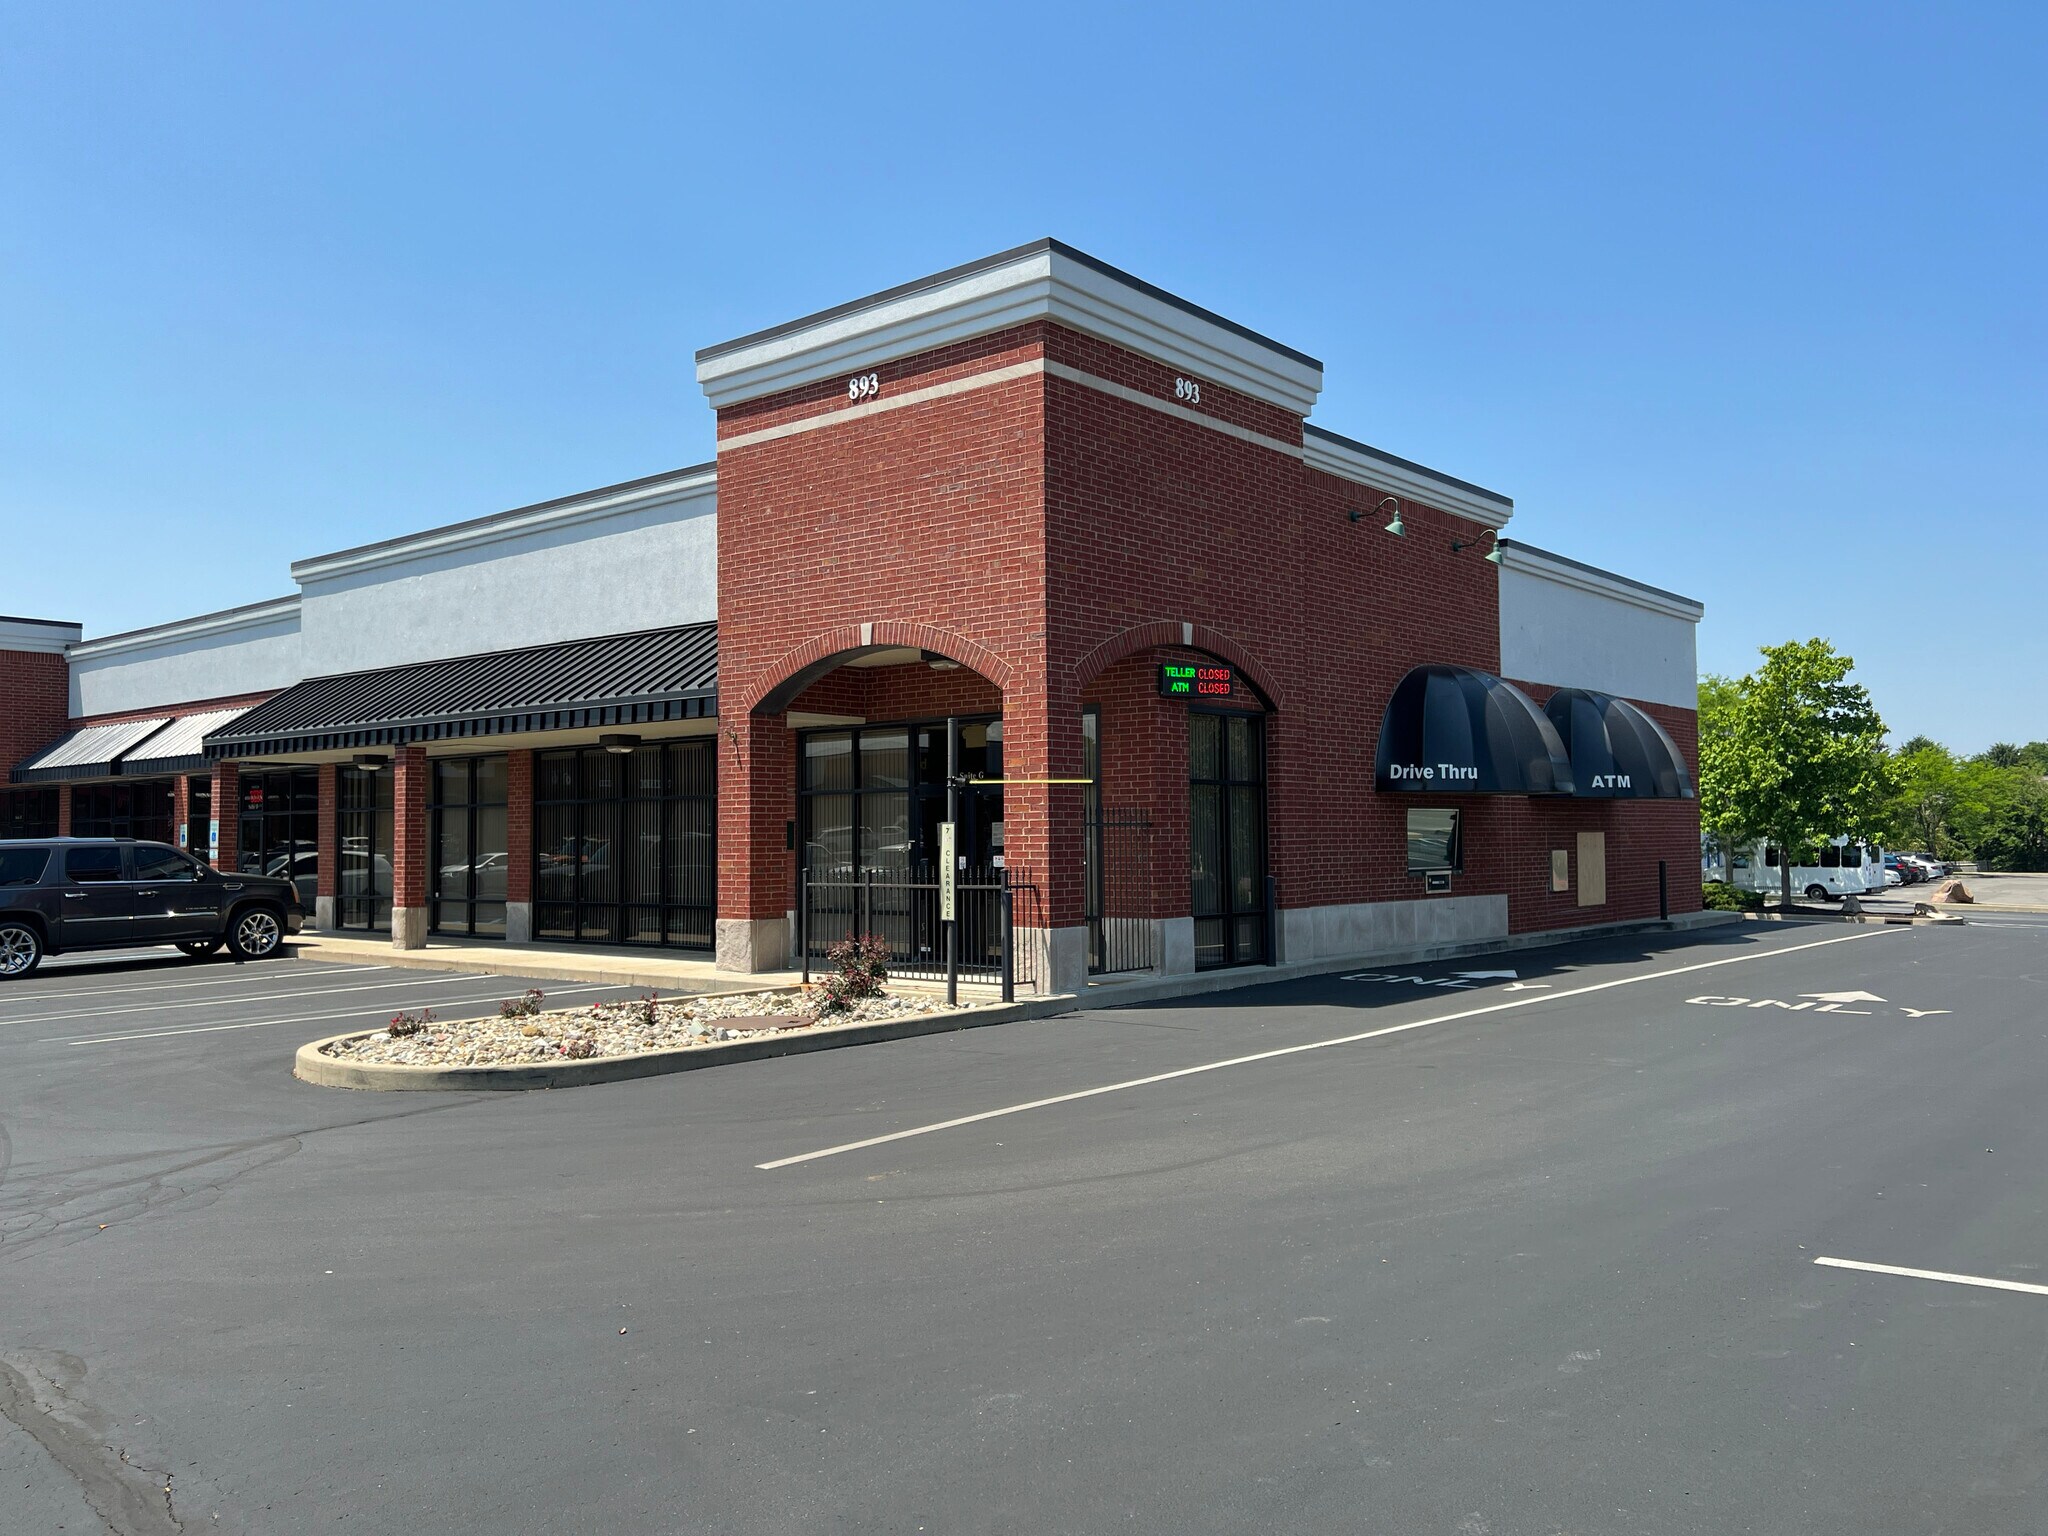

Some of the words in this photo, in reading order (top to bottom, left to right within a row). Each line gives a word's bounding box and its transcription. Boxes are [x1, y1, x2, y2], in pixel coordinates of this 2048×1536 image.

[849, 373, 879, 400] 893
[1175, 377, 1200, 404] 893
[1165, 667, 1196, 678] TELLER
[1198, 668, 1231, 681] CLOSED
[1171, 682, 1190, 693] ATM
[1198, 682, 1231, 695] CLOSED
[959, 771, 977, 780] Suite
[1390, 763, 1434, 780] Drive
[1437, 763, 1478, 780] Thru
[1591, 774, 1631, 788] ATM
